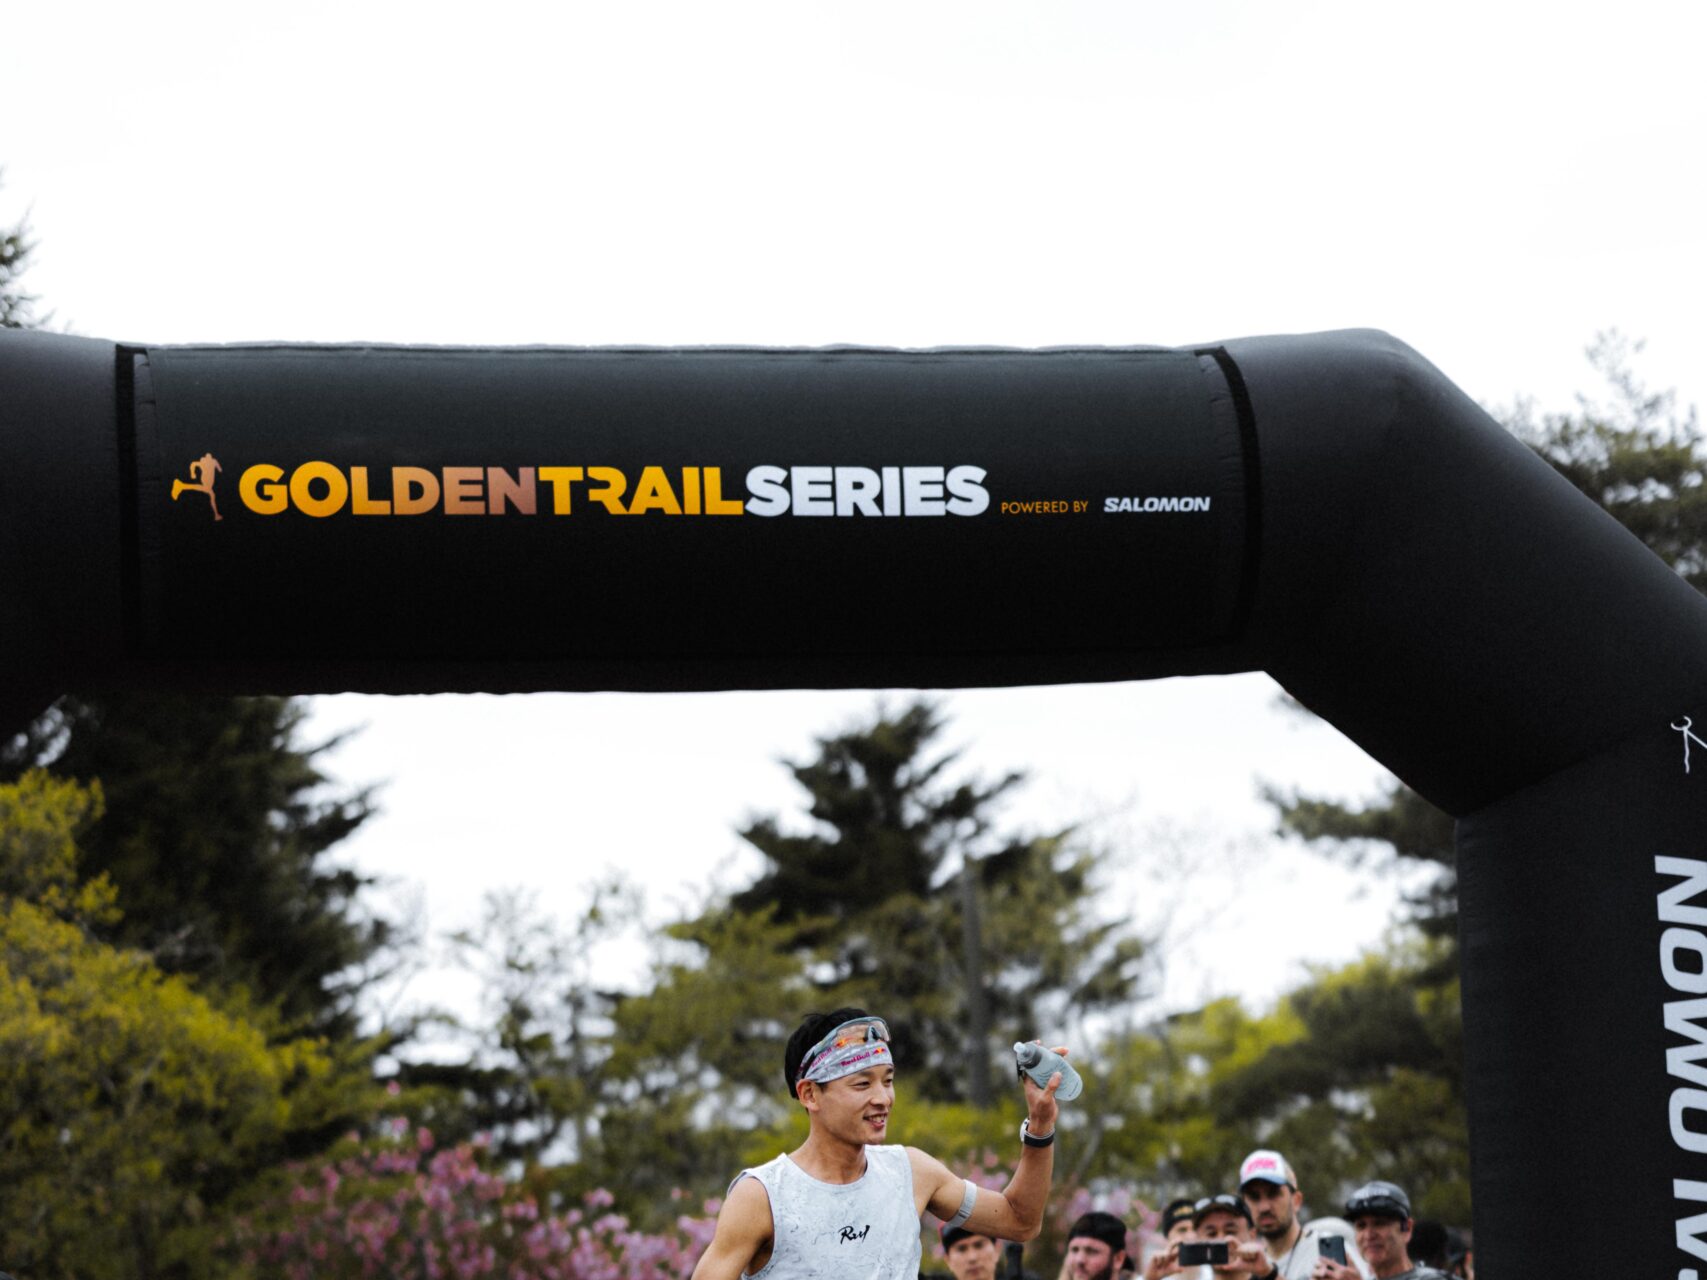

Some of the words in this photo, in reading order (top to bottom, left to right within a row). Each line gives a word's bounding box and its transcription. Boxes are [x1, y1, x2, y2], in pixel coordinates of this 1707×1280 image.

[1002, 501, 1068, 513] POWERED
[1074, 501, 1088, 512] BY
[1104, 497, 1210, 512] SALOMON
